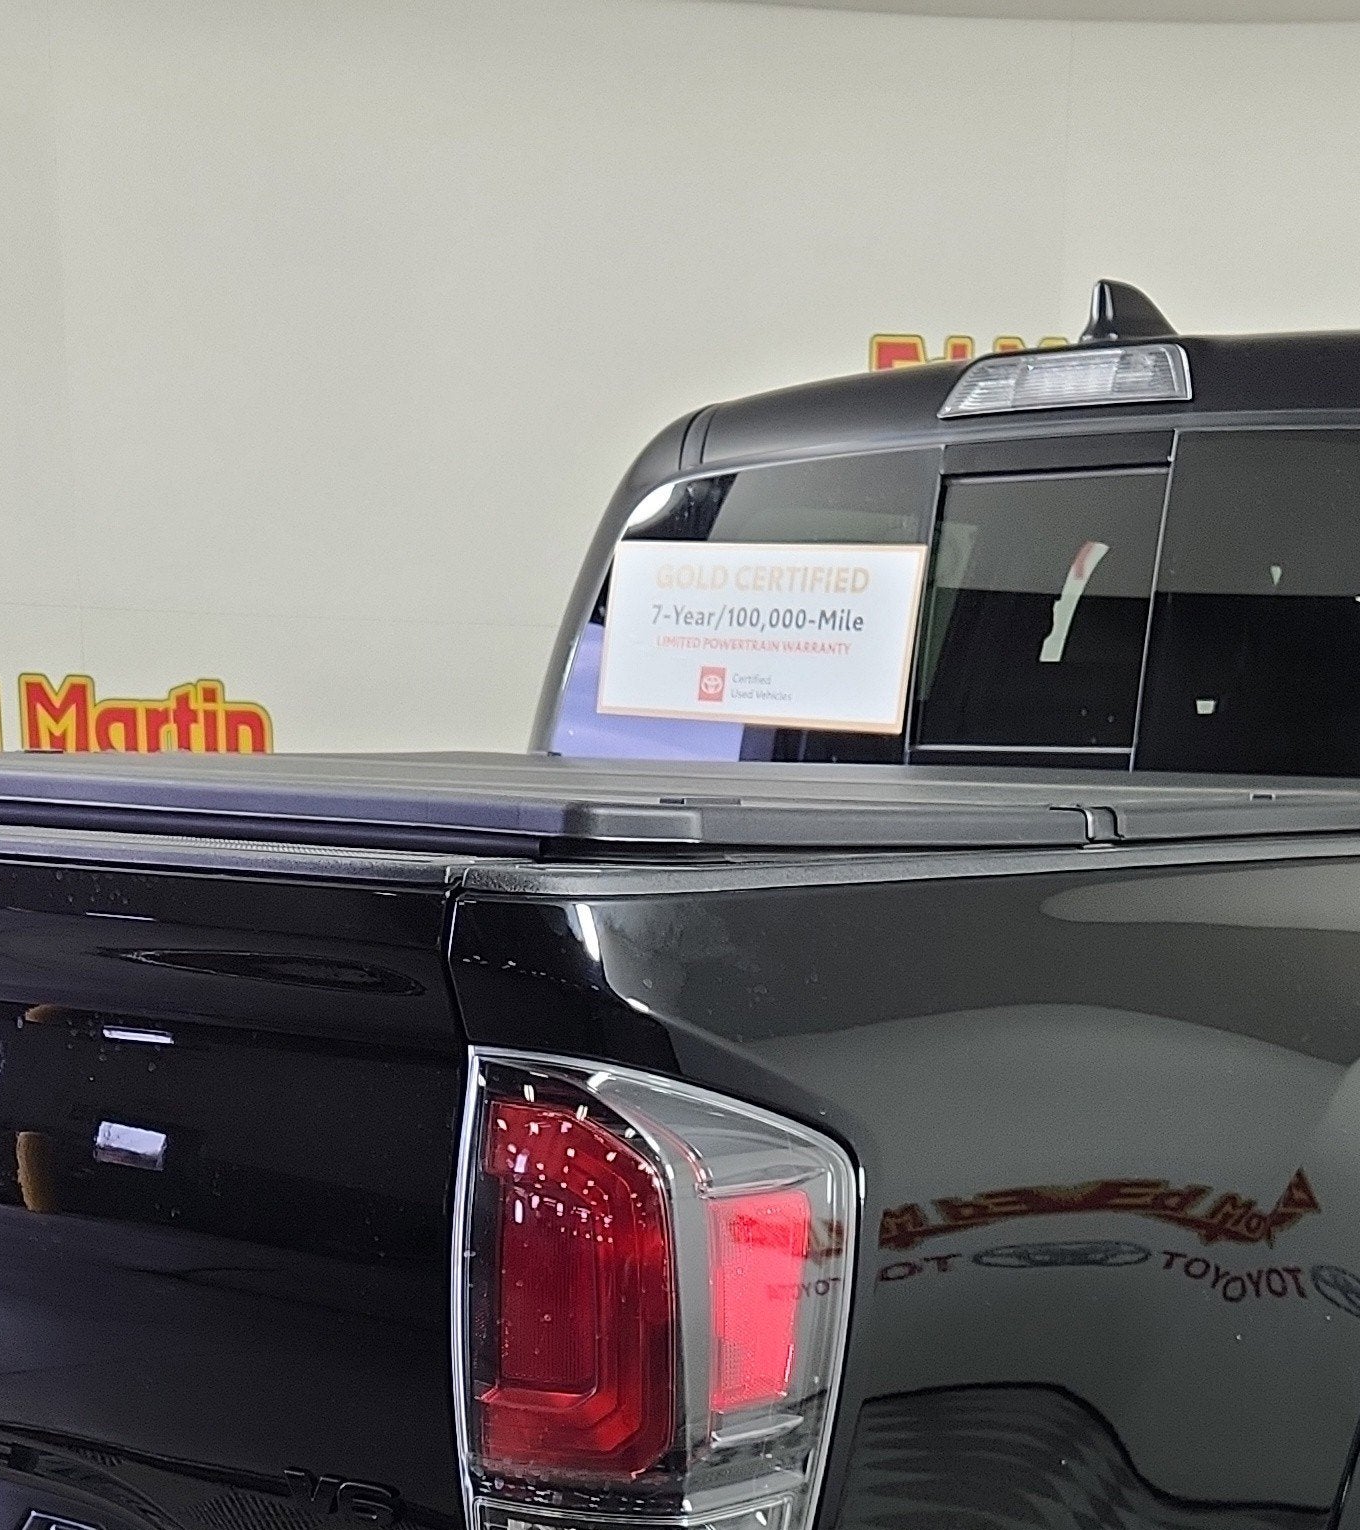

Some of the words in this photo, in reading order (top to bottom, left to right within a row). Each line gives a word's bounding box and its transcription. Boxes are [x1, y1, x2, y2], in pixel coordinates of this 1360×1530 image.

[656, 565, 729, 590] GOLD
[735, 566, 871, 594] CERTIFIED
[651, 604, 864, 632] 7-Year/100,000-Mile
[657, 636, 700, 649] LIMITED
[701, 637, 781, 653] POWERTRAIN
[782, 639, 852, 656] WARRANTY
[19, 674, 274, 753] Martin
